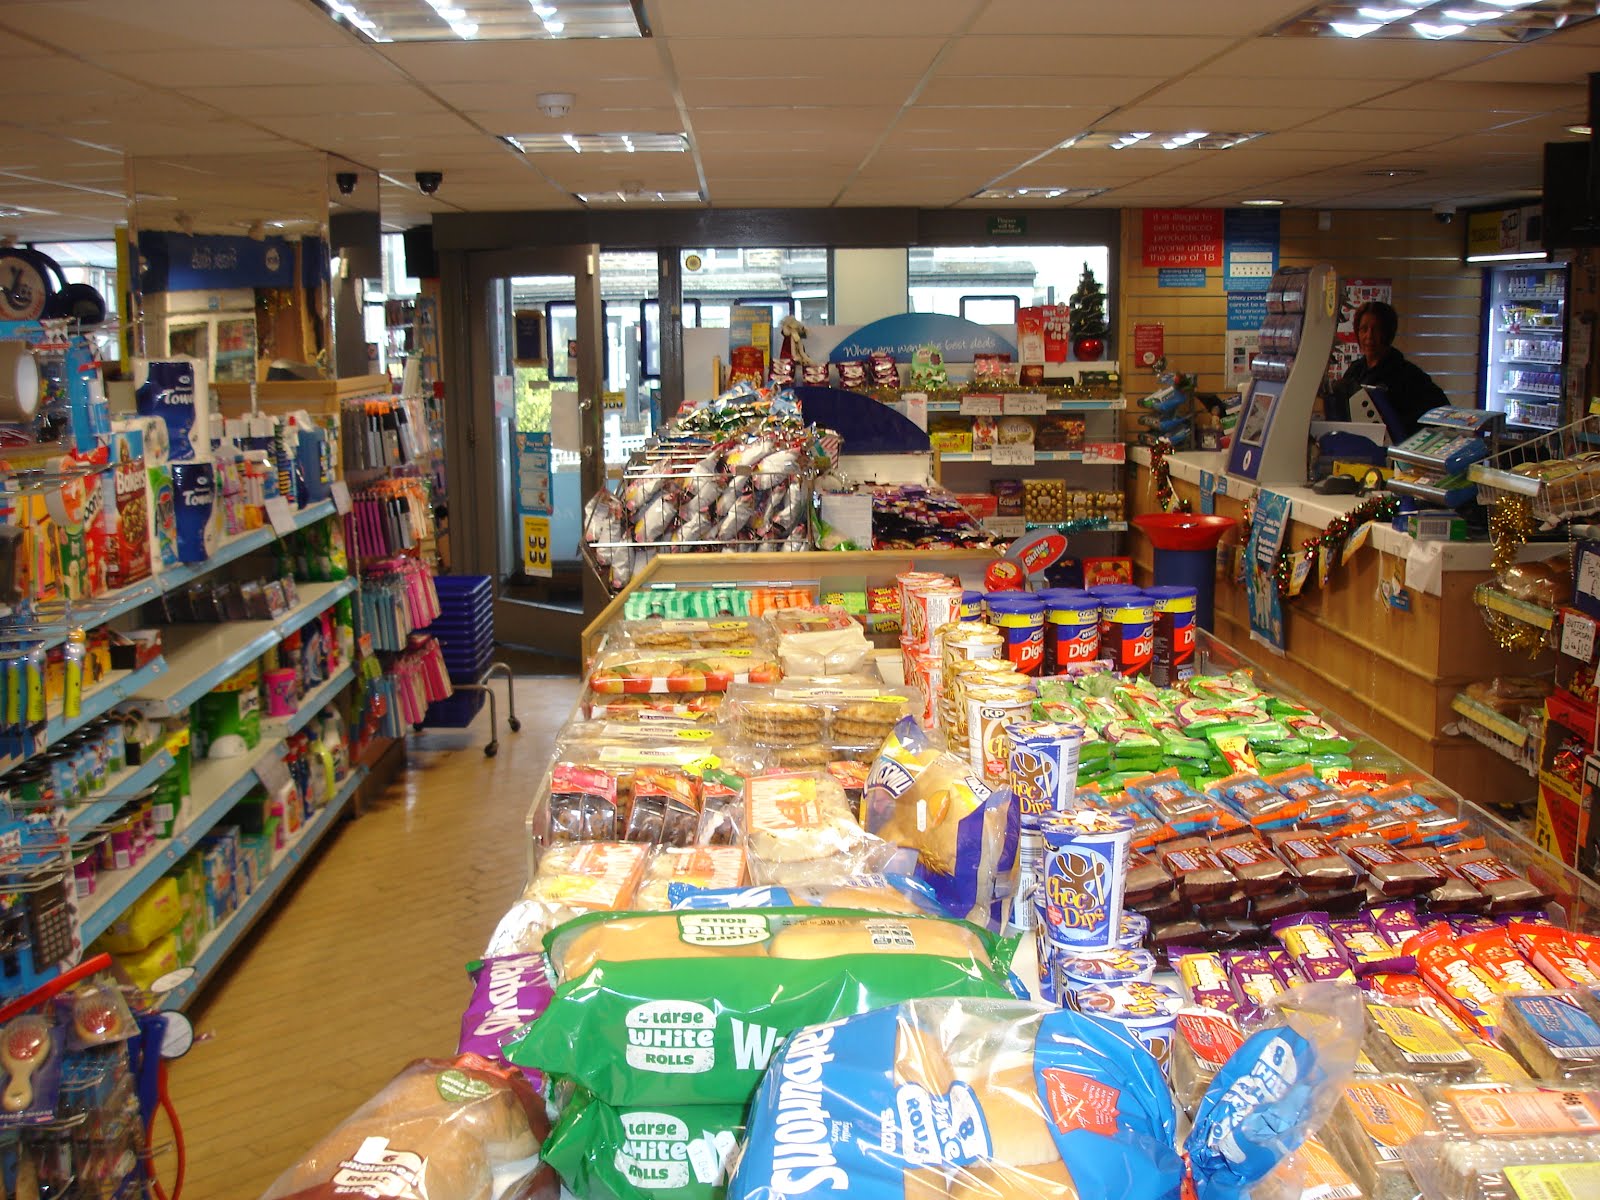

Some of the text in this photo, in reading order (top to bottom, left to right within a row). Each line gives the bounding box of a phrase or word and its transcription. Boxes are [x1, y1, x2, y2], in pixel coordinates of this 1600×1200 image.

[1154, 223, 1212, 232] sell tobacco
[1172, 213, 1199, 223] illegal
[1202, 213, 1212, 221] to
[1154, 233, 1211, 242] products to
[1149, 244, 1216, 254] anyone under
[1150, 253, 1215, 264] the age of 18
[1228, 294, 1246, 302] lottery
[843, 344, 872, 357] When
[944, 340, 967, 350] best
[970, 337, 996, 349] deals
[162, 389, 194, 405] Tow
[183, 490, 212, 506] Tow
[1024, 539, 1050, 567] Skittles
[1096, 574, 1120, 586] Family
[984, 710, 1005, 718] KP
[988, 734, 1009, 759] Ch
[1010, 772, 1037, 800] hoc
[1020, 798, 1052, 816] Dips
[1536, 828, 1551, 852] £1
[1047, 876, 1088, 910] Choc
[1064, 908, 1106, 932] Dips
[1444, 958, 1500, 1004] medley
[1500, 958, 1546, 990] edley
[730, 1017, 787, 1070] W
[646, 1054, 694, 1066] ROLLS
[1272, 1046, 1286, 1066] 8
[771, 1018, 849, 1195] arburtons
[906, 1098, 930, 1154] ROLLS
[958, 1116, 975, 1140] 8
